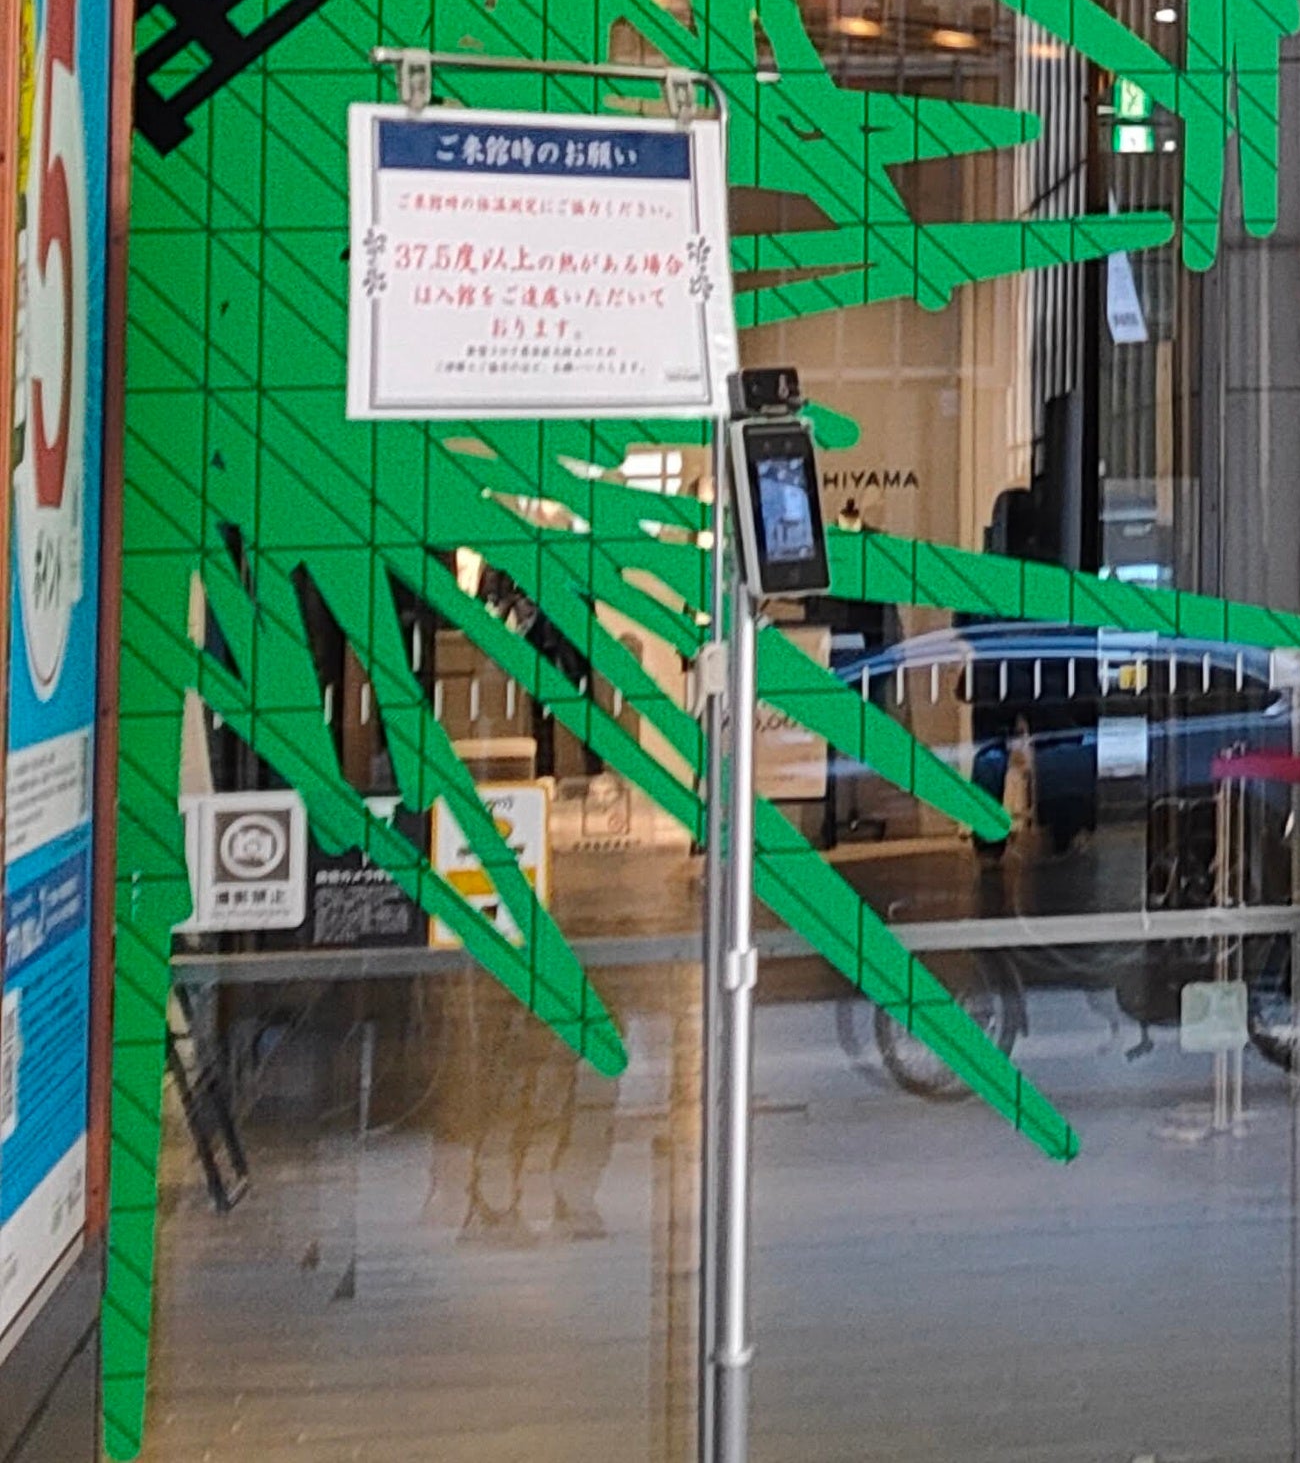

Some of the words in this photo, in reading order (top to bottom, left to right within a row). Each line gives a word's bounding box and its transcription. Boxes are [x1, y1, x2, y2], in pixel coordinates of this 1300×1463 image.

[434, 133, 638, 168] ご来館時のお願い
